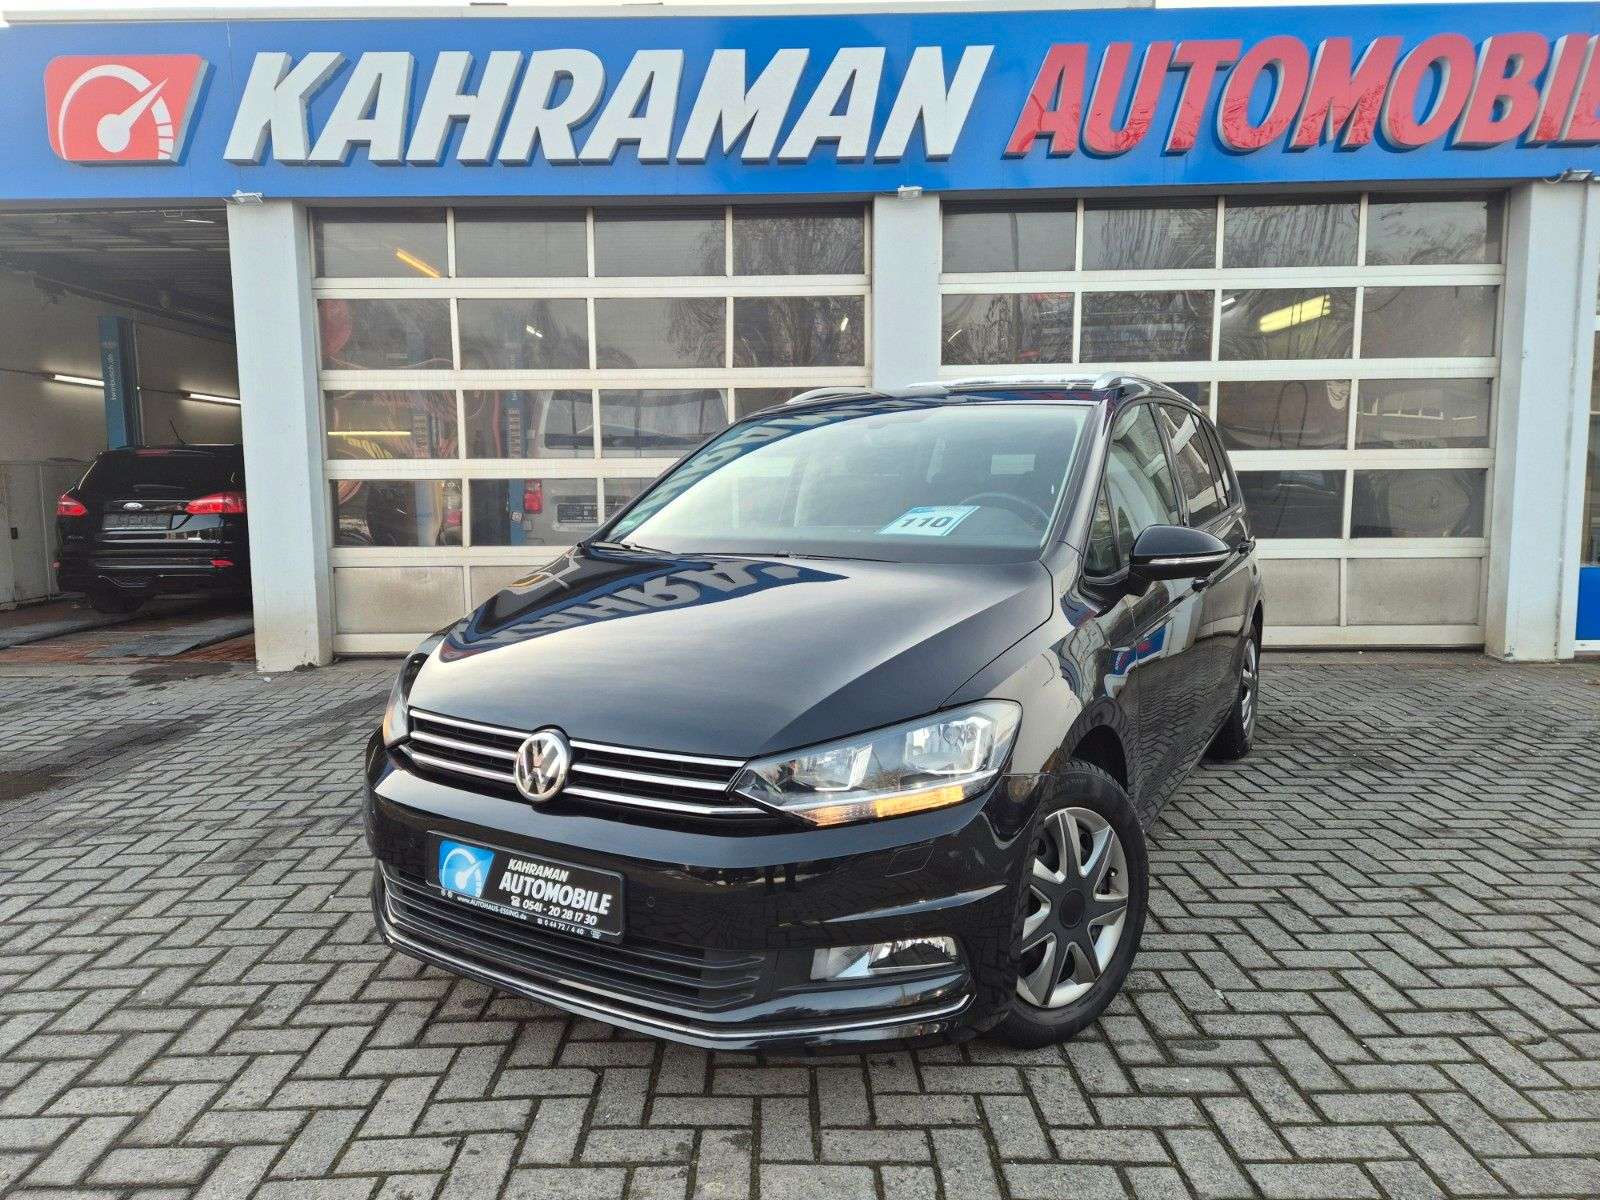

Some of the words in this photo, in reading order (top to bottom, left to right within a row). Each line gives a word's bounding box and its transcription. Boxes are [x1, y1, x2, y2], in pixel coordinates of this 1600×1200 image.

[224, 44, 994, 164] KAHRAMAN
[507, 858, 569, 882] KAHRAMAN
[499, 873, 612, 915] AUTOMOBILE
[548, 904, 561, 917] 20
[562, 908, 574, 921] 28
[575, 911, 583, 922] 17
[583, 914, 598, 927] 30
